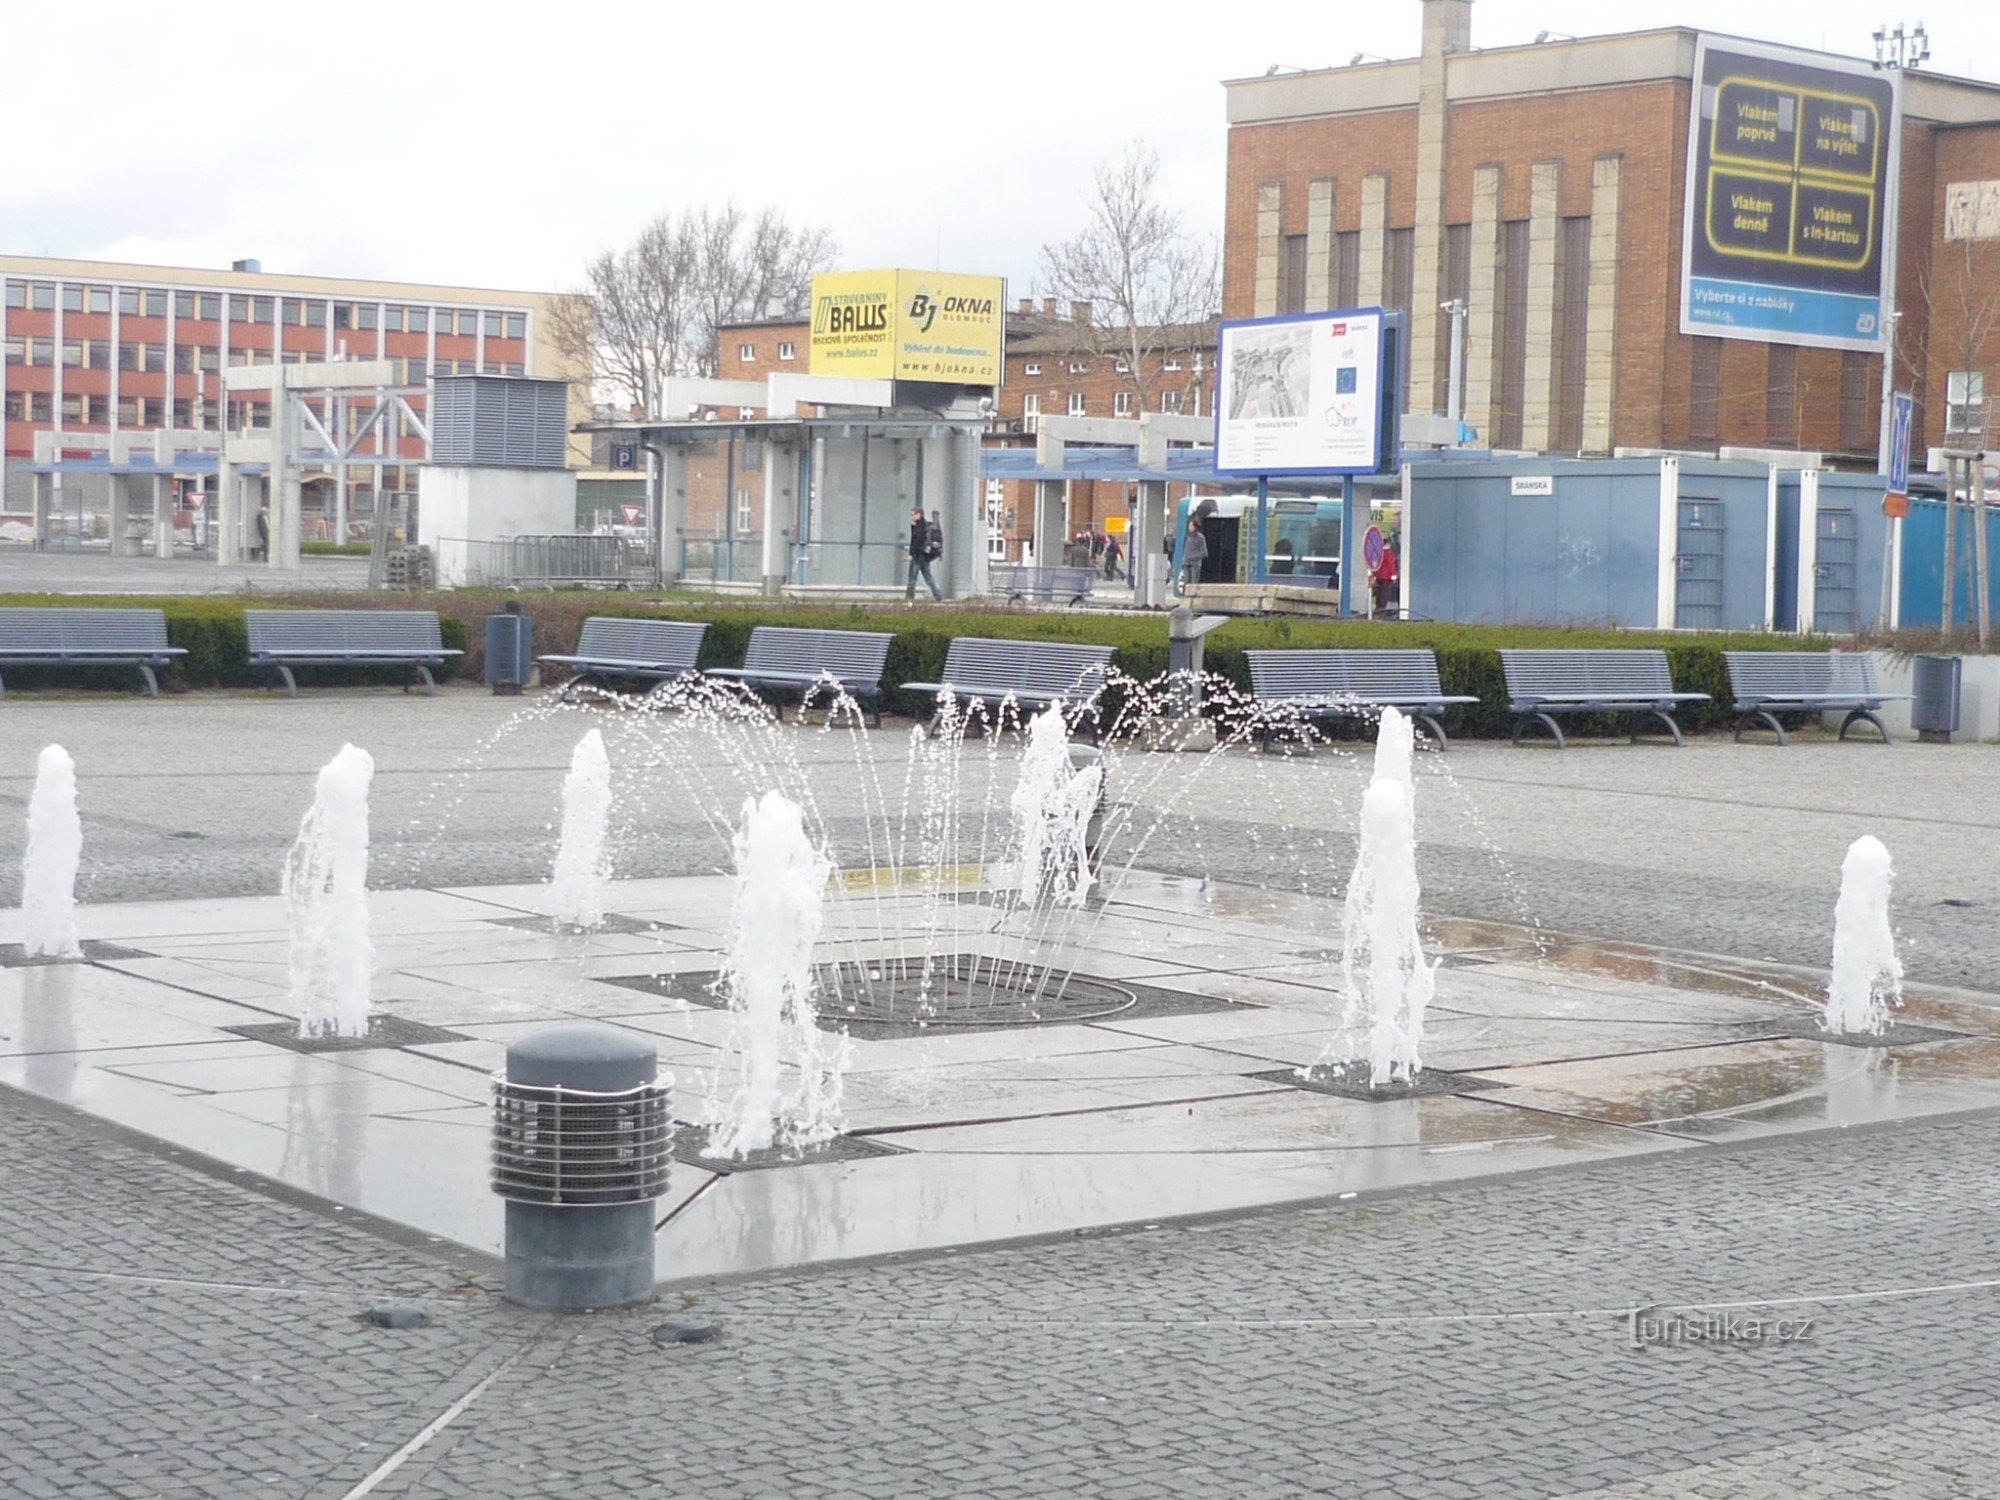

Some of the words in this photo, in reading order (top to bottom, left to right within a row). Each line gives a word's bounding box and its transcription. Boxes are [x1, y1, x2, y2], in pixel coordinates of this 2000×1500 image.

[1737, 104, 1778, 123] Vlakem
[1819, 116, 1857, 135] Vlakem
[1737, 126, 1776, 143] poprvé
[1816, 138, 1830, 150] na
[1832, 138, 1858, 155] výlet
[1731, 195, 1773, 213] Vlakem
[1733, 215, 1769, 232] denně
[1813, 206, 1852, 224] Vlakem
[1803, 227, 1809, 238] s
[834, 293, 888, 305] STAVEBNINY
[943, 297, 992, 315] OKNA
[1695, 289, 1735, 304] Vyberte
[1737, 293, 1746, 305] si
[1748, 296, 1754, 307] z
[831, 304, 887, 333] BALUS
[943, 314, 991, 323] OLOMOUC
[903, 363, 993, 375] www.bjokna.cz
